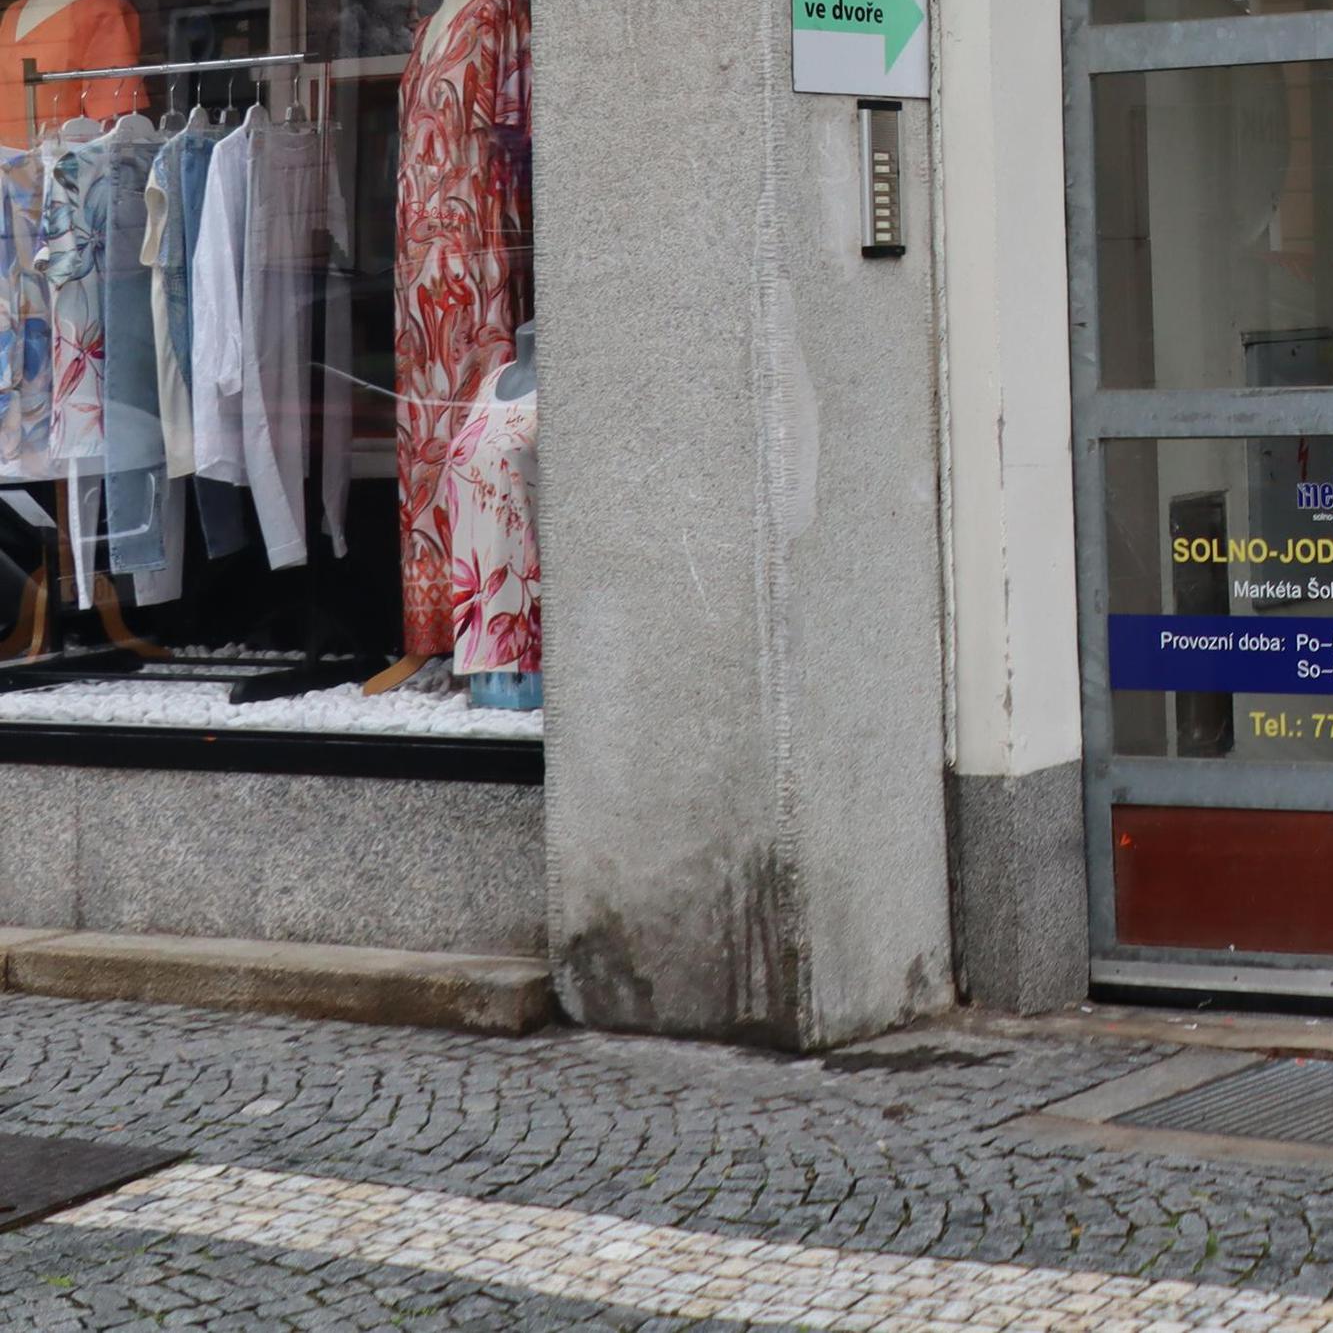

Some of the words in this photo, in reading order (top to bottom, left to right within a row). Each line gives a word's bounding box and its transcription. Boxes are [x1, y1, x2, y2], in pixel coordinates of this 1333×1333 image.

[804, 2, 826, 19] ve
[832, 0, 884, 24] dvoře
[1233, 580, 1302, 599] Markéta
[1160, 631, 1234, 653] Provozní
[1238, 632, 1286, 653] doba:
[1249, 712, 1303, 738] Tel.:
